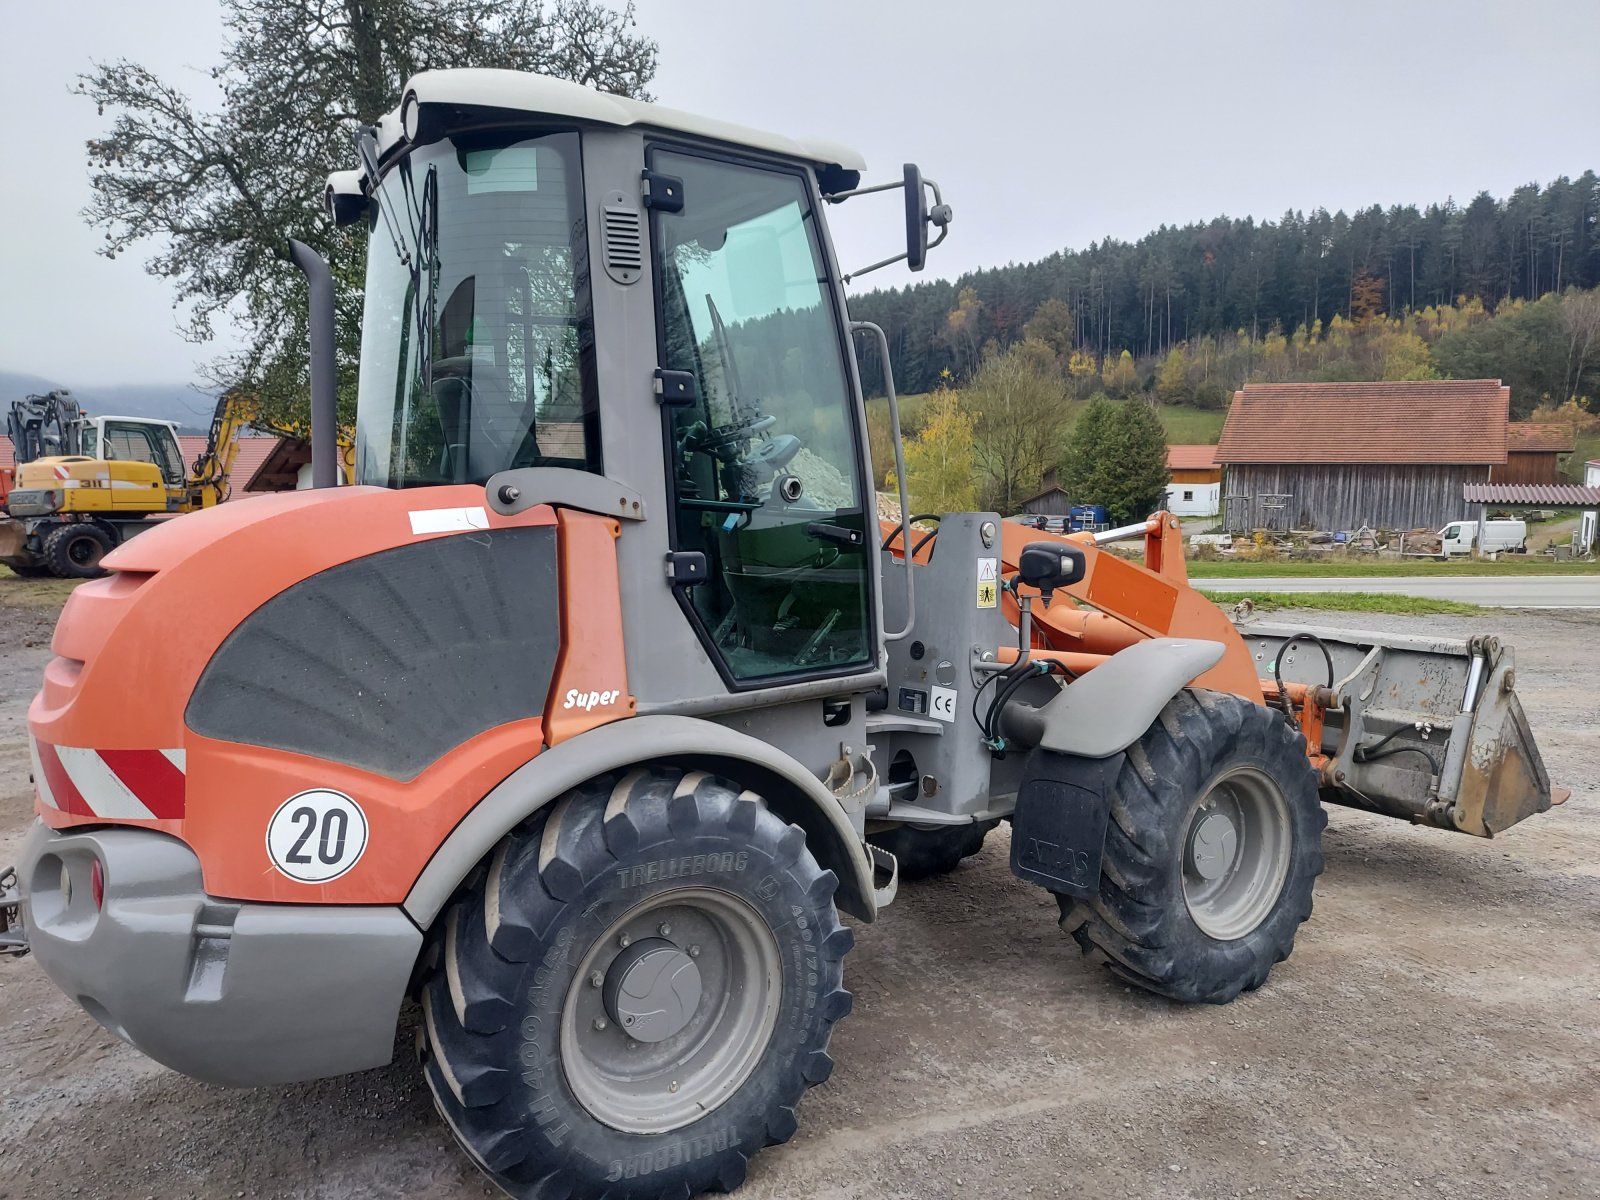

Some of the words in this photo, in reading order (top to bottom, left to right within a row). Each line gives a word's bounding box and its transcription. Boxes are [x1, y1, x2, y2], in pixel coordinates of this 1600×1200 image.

[80, 479, 103, 489] 311
[563, 688, 620, 712] Super
[934, 695, 953, 714] CE
[285, 806, 349, 866] 20
[615, 851, 750, 889] TRELLEBORG
[519, 1014, 545, 1091] 400
[526, 1093, 571, 1149] TH
[603, 1124, 743, 1183] TRELLEBORG
